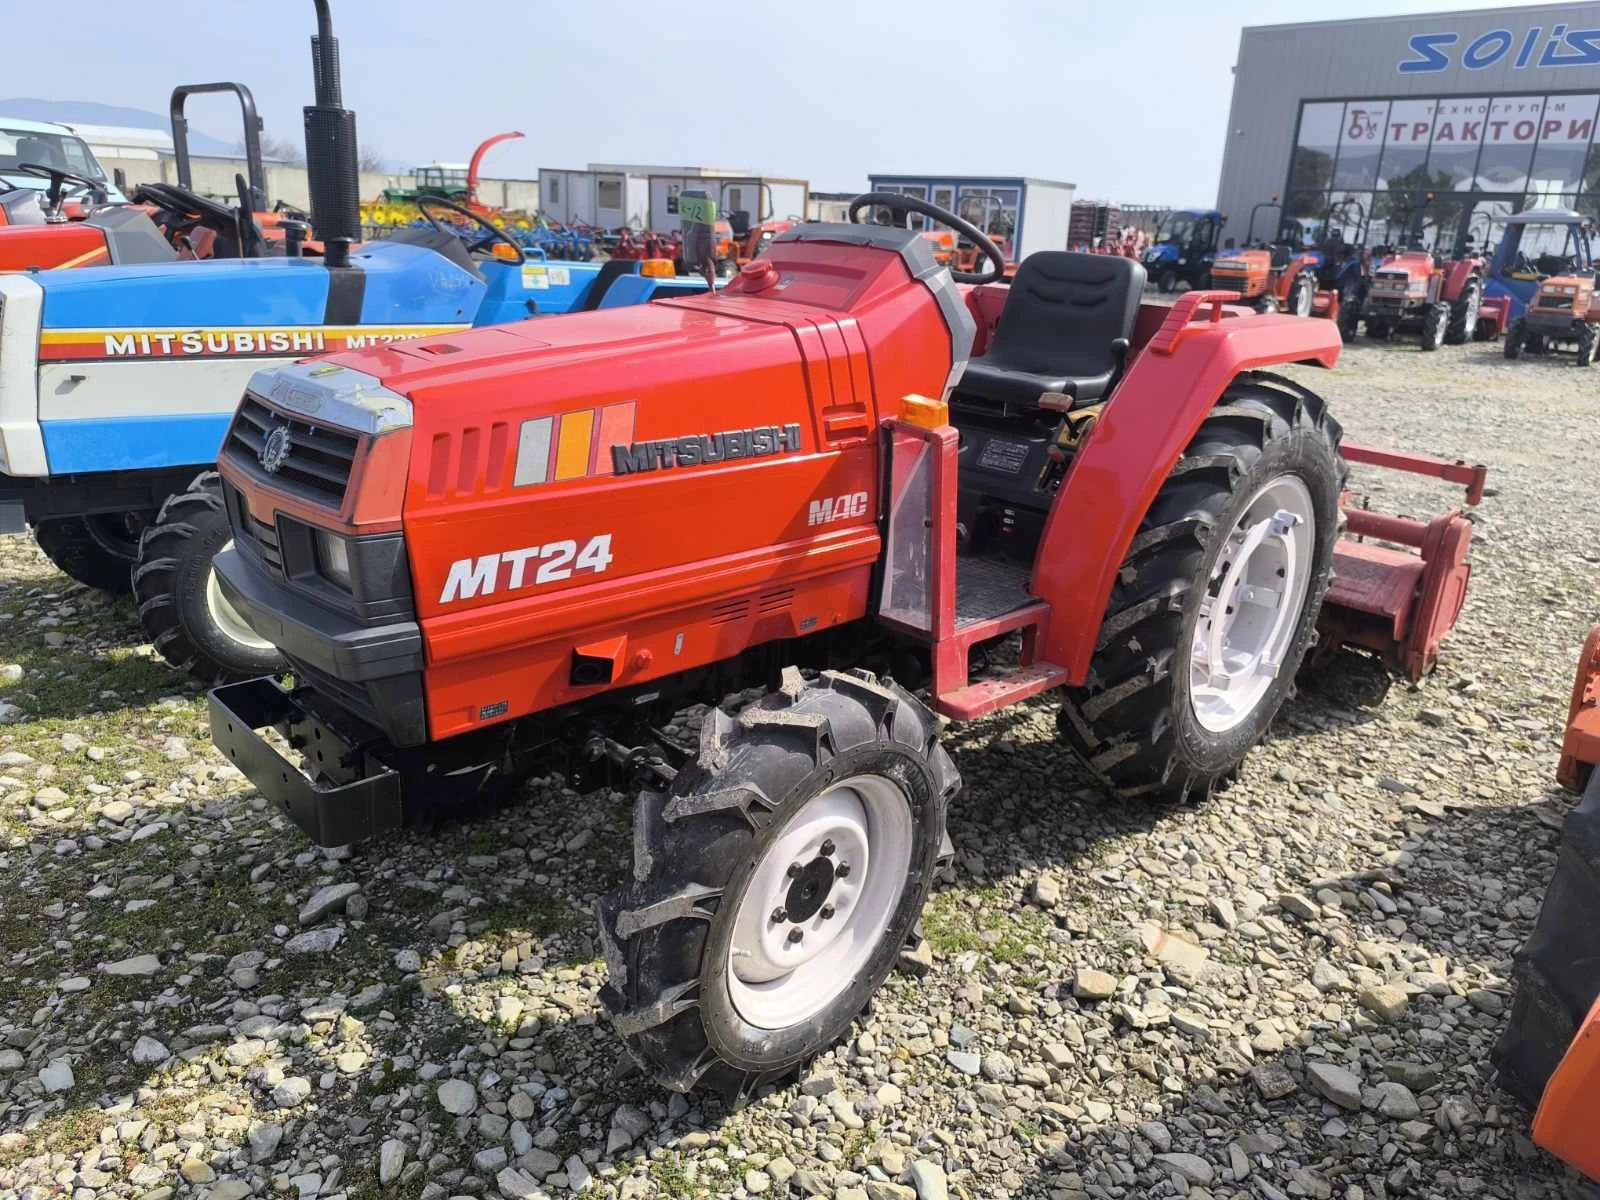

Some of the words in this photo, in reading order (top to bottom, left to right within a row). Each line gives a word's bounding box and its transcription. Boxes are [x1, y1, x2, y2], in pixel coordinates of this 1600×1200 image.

[1391, 119, 1592, 141] ТРАКТОРИ
[104, 331, 325, 356] MITSUBISHI
[611, 423, 801, 475] MITSUBISHI
[808, 491, 868, 526] MAC
[439, 533, 613, 604] MT24
